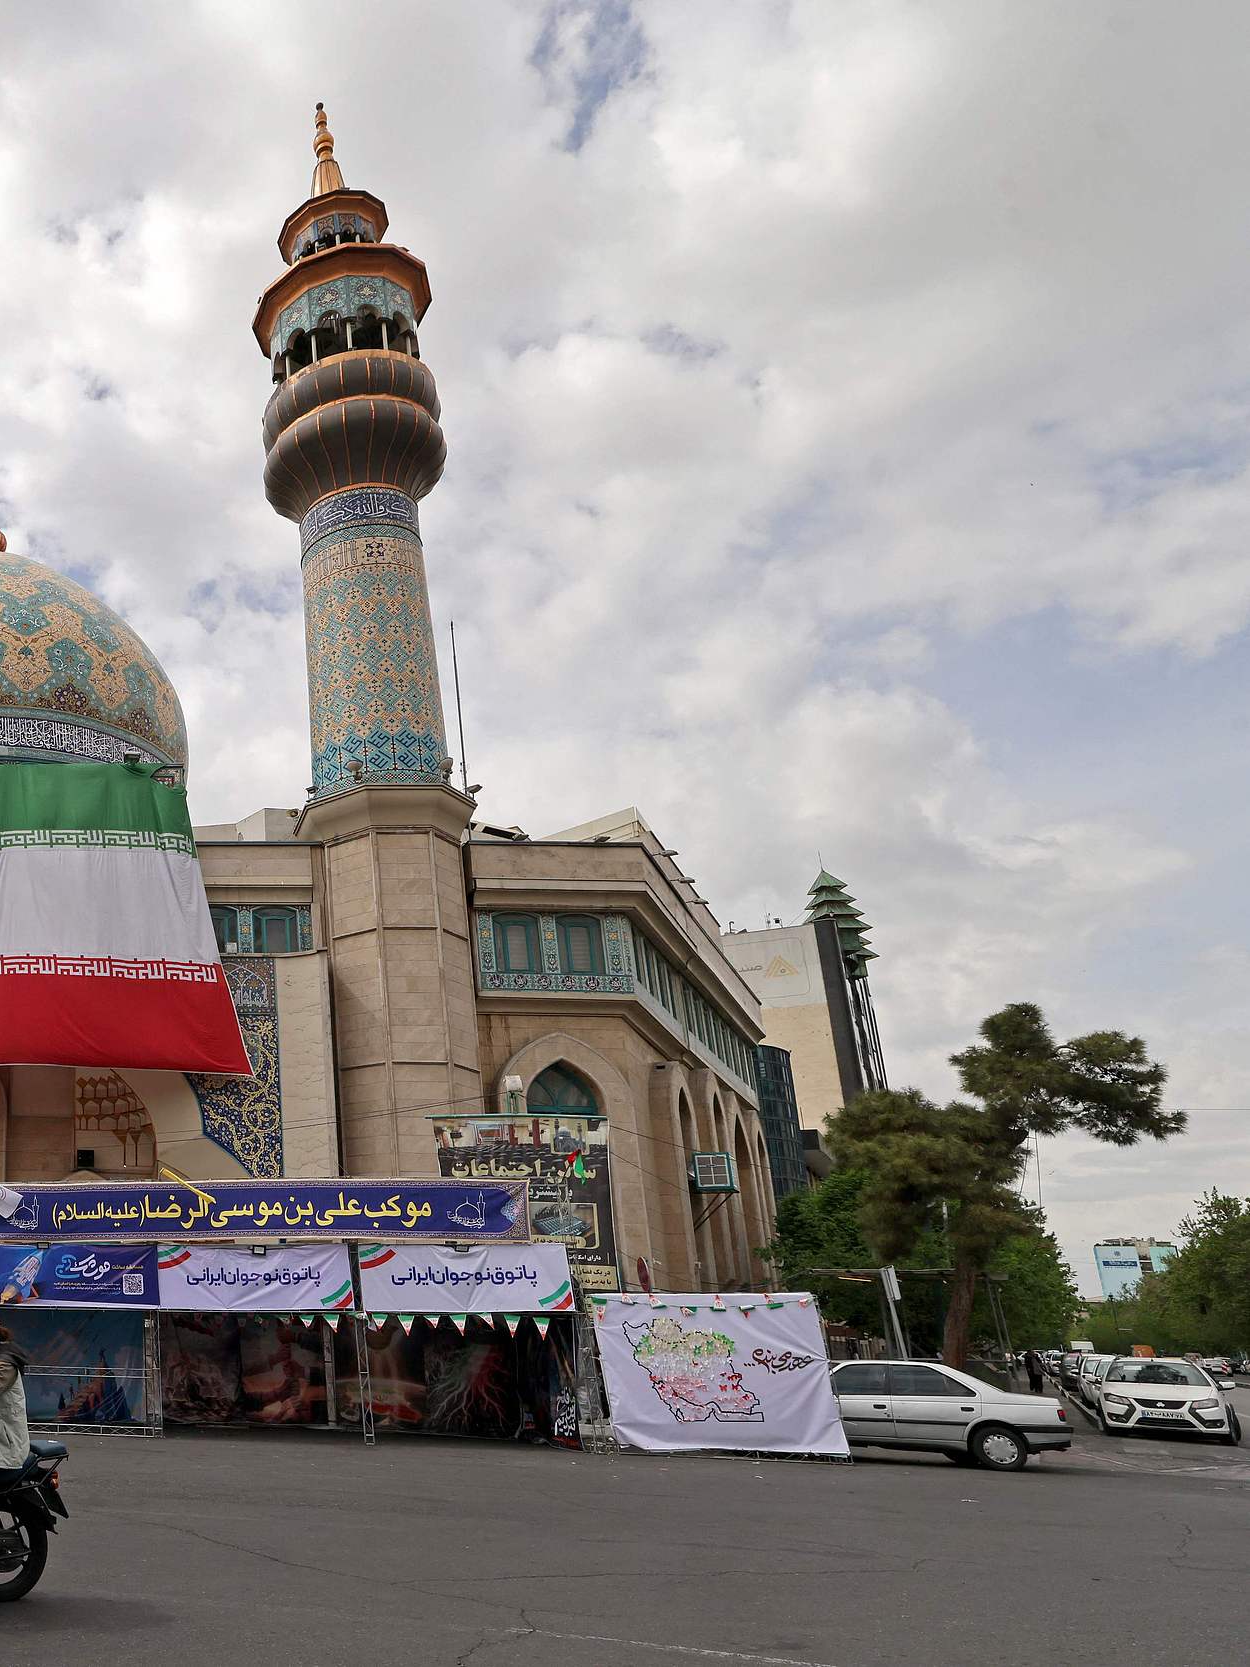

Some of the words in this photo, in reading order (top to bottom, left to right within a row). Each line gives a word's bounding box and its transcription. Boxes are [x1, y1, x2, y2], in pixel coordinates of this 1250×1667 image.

[452, 1159, 542, 1178] اجتماعات
[210, 1201, 283, 1228] موسی
[285, 1196, 314, 1226] بن
[315, 1191, 363, 1227] علی
[363, 1195, 432, 1228] موکب
[186, 1266, 224, 1287] ایرانی
[224, 1267, 279, 1287] نوجوان
[279, 1265, 321, 1288] پاتوق
[391, 1266, 432, 1287] ایرانی
[432, 1266, 491, 1287] نوجوان
[490, 1264, 537, 1288] پاتوق
